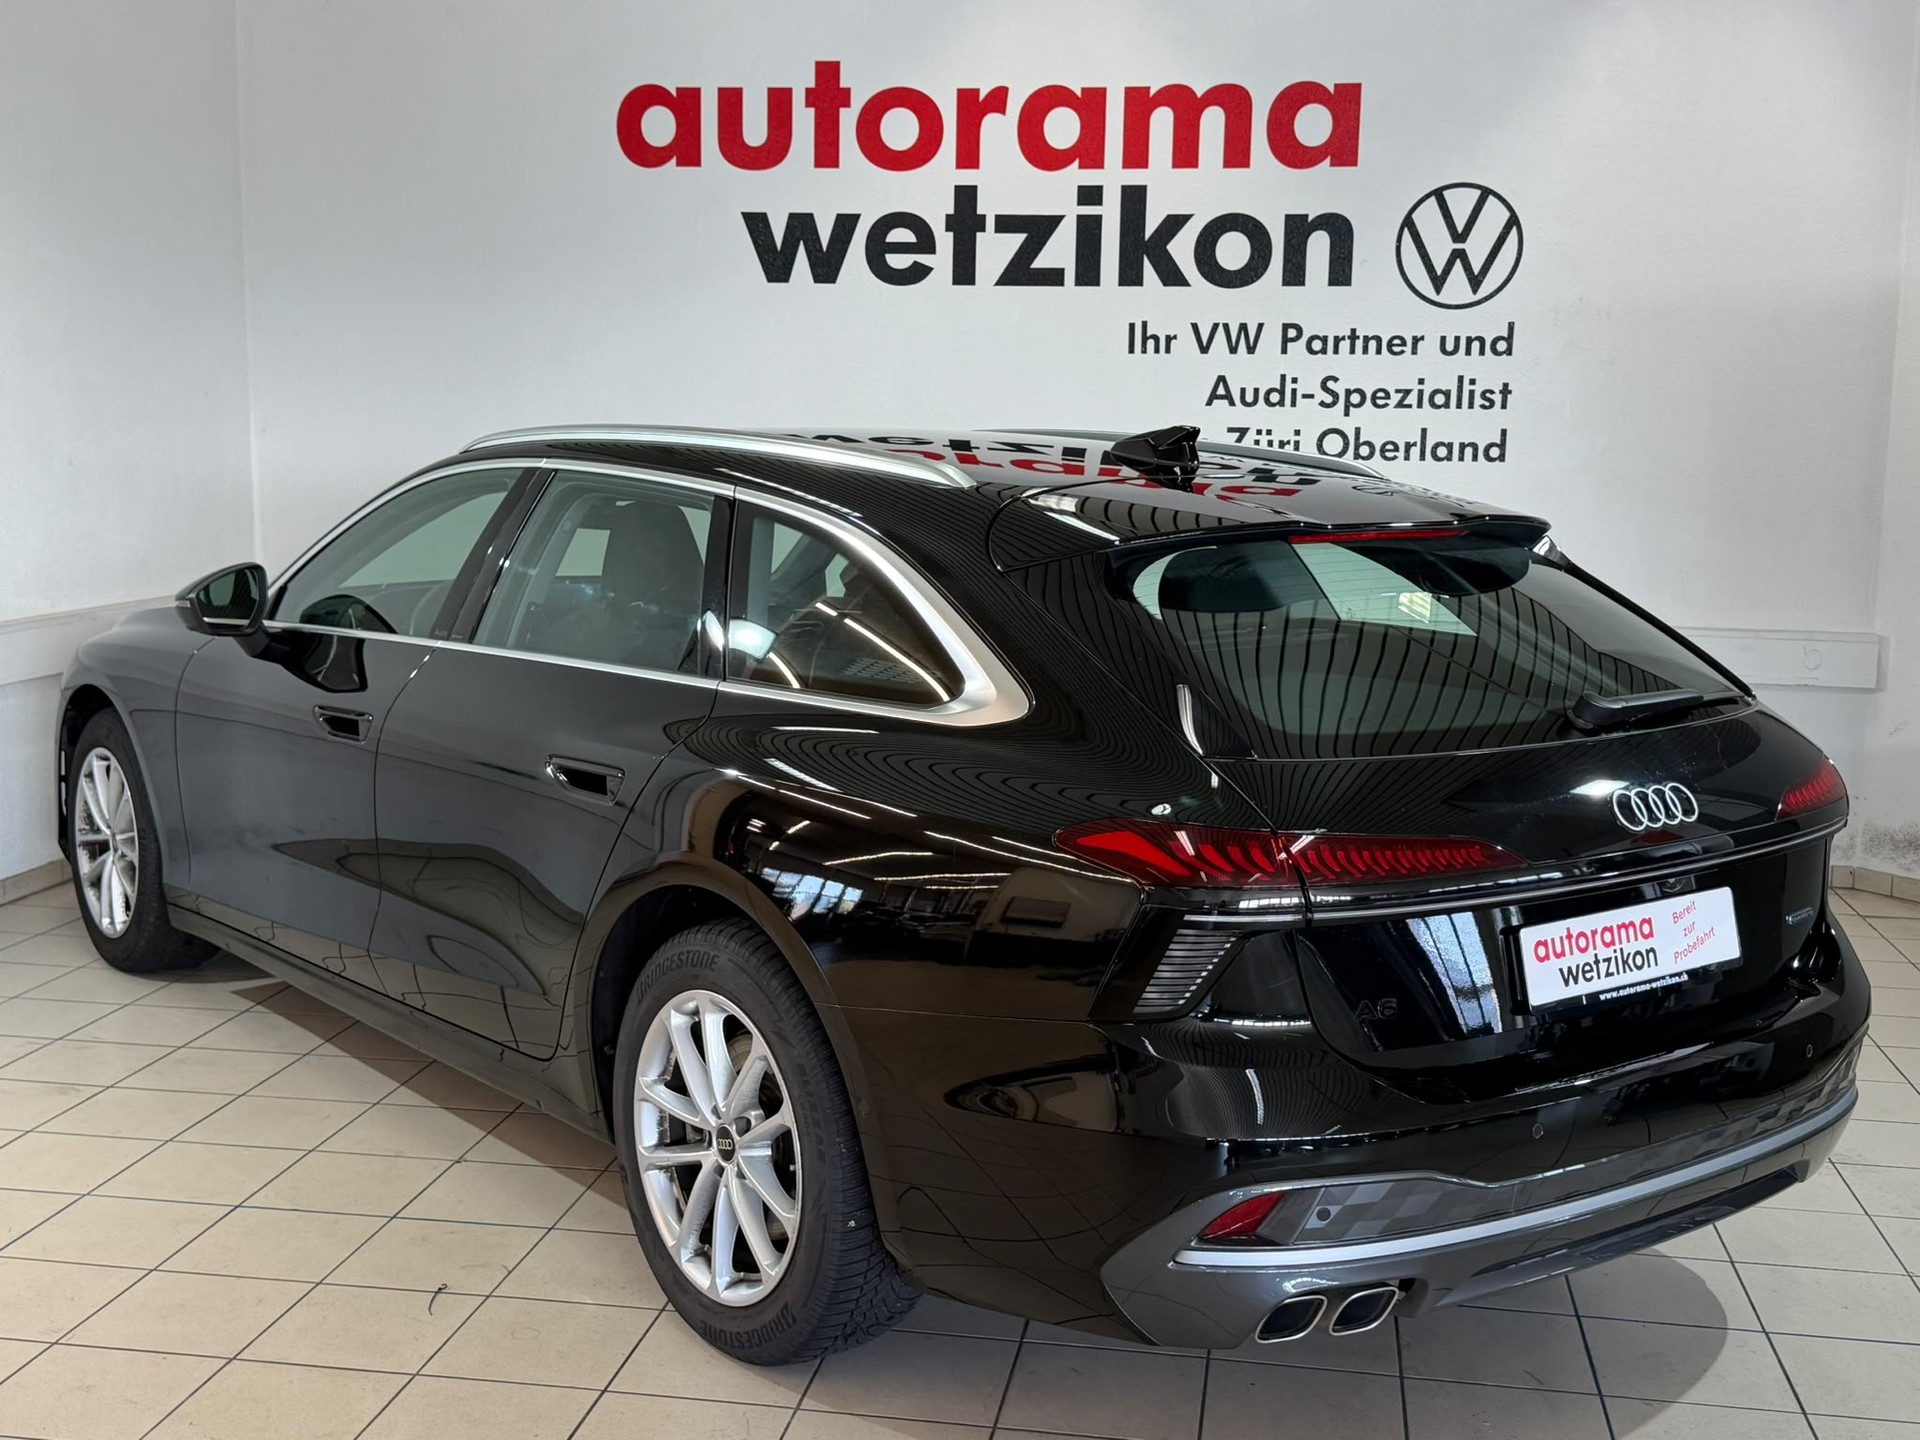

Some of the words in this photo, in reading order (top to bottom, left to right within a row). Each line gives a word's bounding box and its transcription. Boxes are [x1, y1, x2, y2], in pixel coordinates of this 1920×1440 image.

[617, 61, 1361, 171] autorama
[741, 185, 1354, 288] wetzikon
[1129, 321, 1177, 354] Ihr
[1191, 323, 1264, 354] VW
[1281, 323, 1424, 356] Partner
[1440, 322, 1514, 356] und
[1206, 374, 1512, 416] Audi-Spezialist
[1315, 427, 1507, 463] Oberland
[1672, 900, 1697, 924] Bereit
[1682, 921, 1696, 938] zur
[1533, 917, 1655, 963] autorama
[1673, 926, 1716, 964] Probefahrt
[1558, 946, 1659, 988] wetzikon
[1353, 997, 1398, 1022] A6
